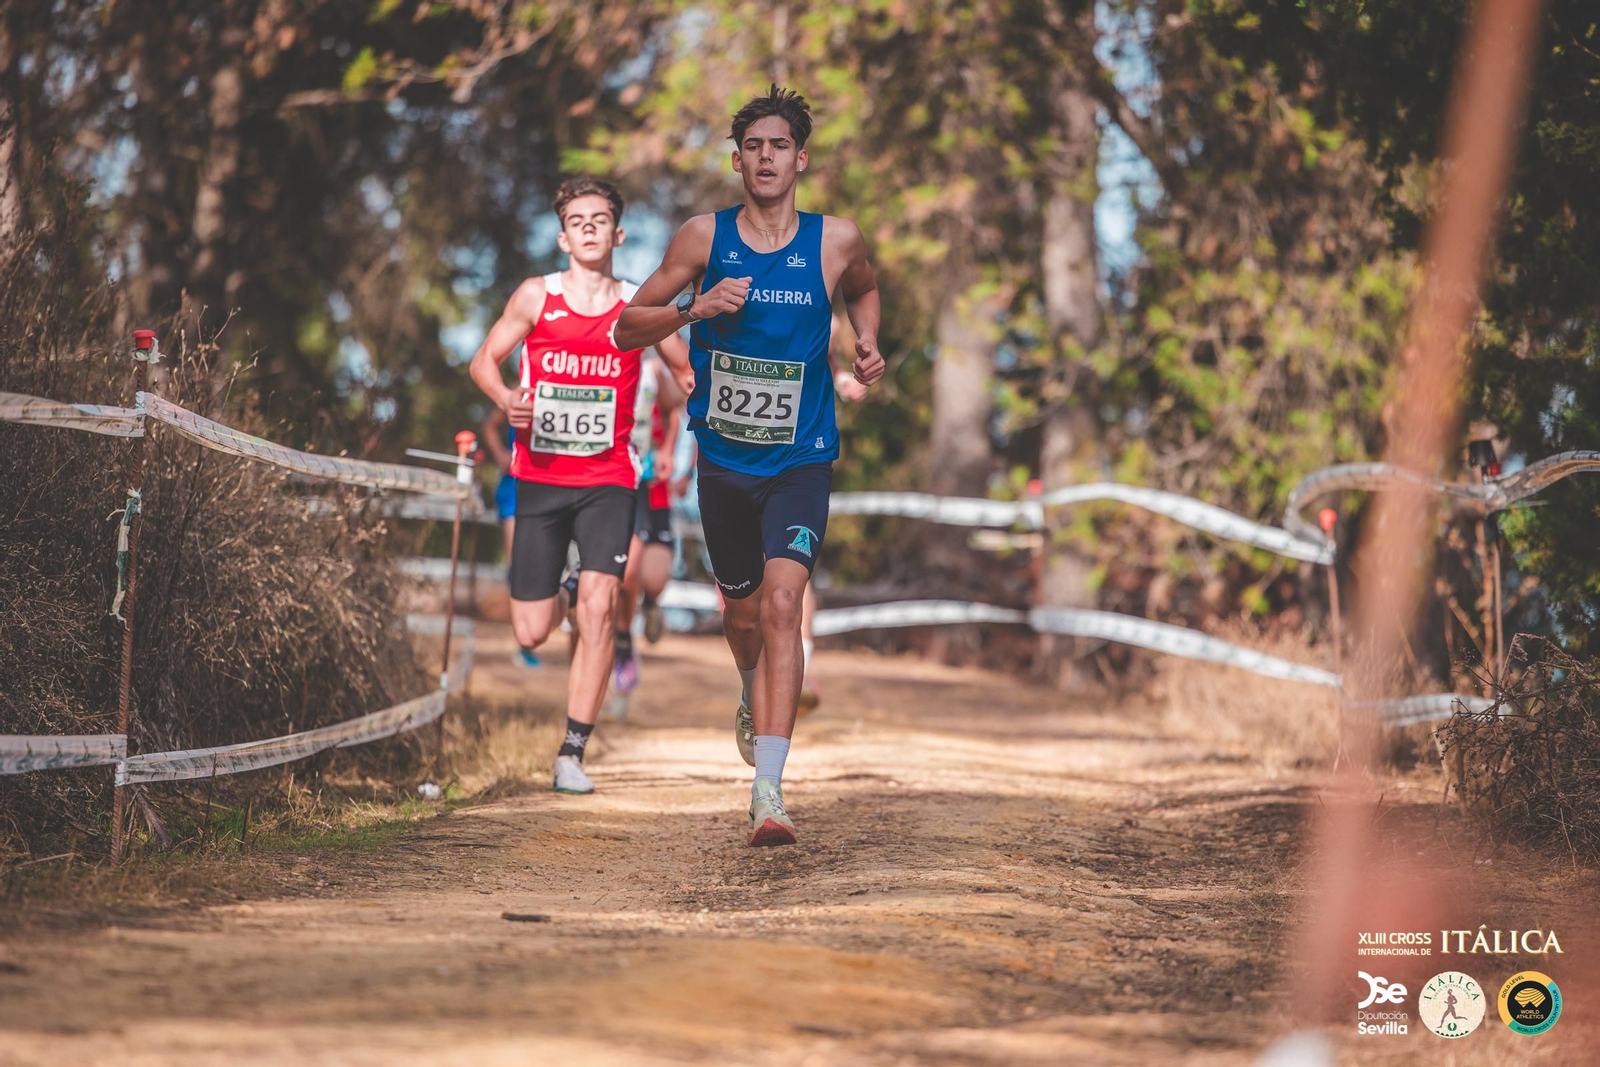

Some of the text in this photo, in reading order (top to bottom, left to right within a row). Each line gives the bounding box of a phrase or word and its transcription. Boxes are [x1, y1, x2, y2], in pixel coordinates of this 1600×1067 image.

[542, 350, 622, 379] CURTIUS
[735, 359, 779, 374] ITÁLICA
[717, 385, 792, 421] 8225
[541, 411, 607, 435] 8165
